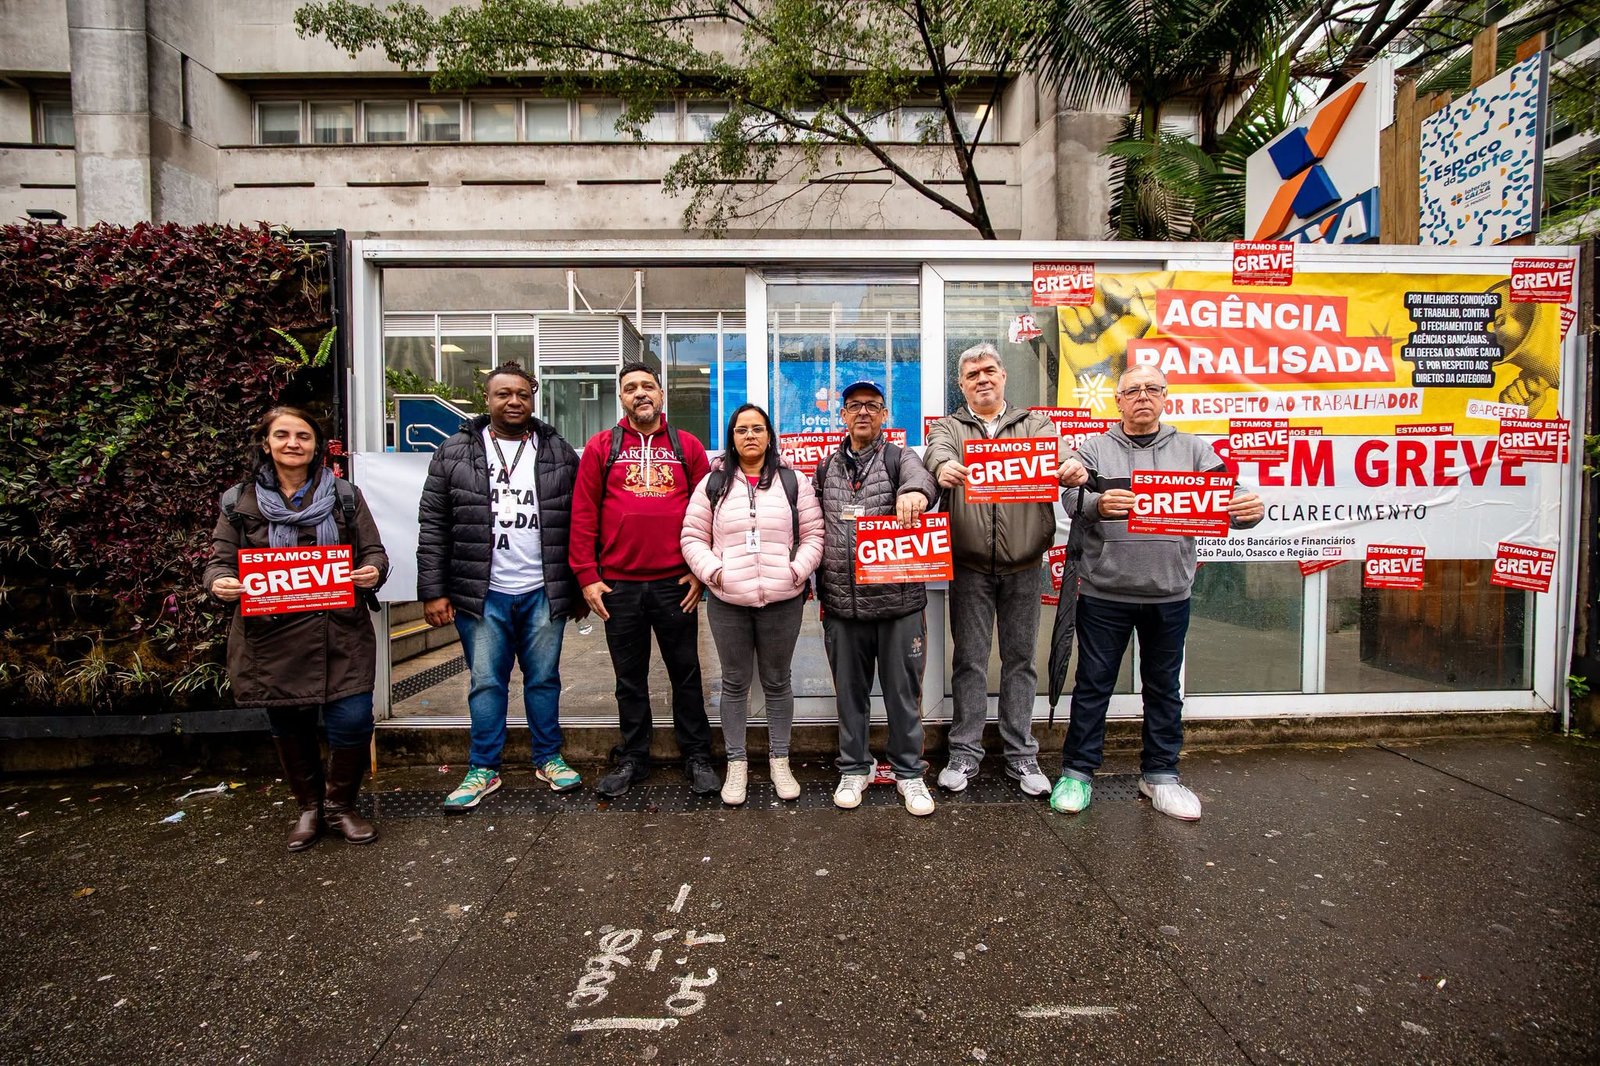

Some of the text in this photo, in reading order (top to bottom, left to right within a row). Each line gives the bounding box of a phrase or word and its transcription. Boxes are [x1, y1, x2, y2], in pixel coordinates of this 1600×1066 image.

[1434, 140, 1502, 181] Espaço
[1443, 149, 1513, 187] da Sorte
[1464, 185, 1491, 201] CAIXA
[1234, 243, 1277, 251] ESTAMOS
[1233, 252, 1293, 272] GREVE
[1513, 261, 1555, 269] ESTAMOS
[1033, 274, 1095, 293] GREVE
[1511, 270, 1572, 290] GREVE
[1408, 293, 1498, 306] POR MELHORES CONDIÇÕES
[1162, 294, 1341, 332] AGÊNCIA
[1413, 308, 1490, 319] DE TRABALHO, CONTRA
[1421, 321, 1484, 331] O FECHAMENTO DE
[1412, 333, 1490, 345] AGÊNCIAS BANCÁRIAS,
[1404, 346, 1501, 357] EM DEFESA DO SAÚDE CAIXA
[1135, 345, 1391, 376] PARALISADA
[1418, 360, 1489, 370] E POR RESPEITO AOS
[1415, 373, 1491, 384] DIRETOS DA CATEGORIA
[1164, 392, 1419, 416] OR RESPEITO AO TRABALHADOR
[1469, 403, 1526, 418] @APCEFSP
[1061, 421, 1105, 429] ESTAMOS
[1396, 425, 1453, 434] ESTAMOS EM
[1501, 420, 1543, 429] ESTAMOS
[781, 436, 824, 444] ESTAMOS
[1229, 430, 1288, 450] GREVE
[1500, 430, 1558, 448] GREVE
[966, 442, 1031, 454] ESTAMOS
[1035, 441, 1056, 451] EM
[966, 453, 1057, 485] GREVE
[1134, 474, 1233, 487] ESTAMOS EM
[1132, 489, 1231, 516] GREVE
[1268, 504, 1428, 522] CLARECIMENTO
[858, 517, 947, 531] ESTAMS EM
[857, 529, 950, 564] GREVE
[1228, 536, 1245, 545] dos
[1247, 536, 1292, 546] Bancários
[1301, 536, 1356, 545] Financiários
[241, 549, 350, 563] ESTAMOS EM
[1197, 548, 1214, 557] São
[1216, 548, 1244, 558] Paulo,
[1246, 549, 1277, 557] Osasco
[1287, 548, 1319, 559] Região
[1322, 547, 1342, 556] CUT
[1367, 546, 1424, 556] ESTAMOS EM
[1498, 545, 1555, 560] ESTAMOS EM
[1366, 557, 1424, 575] GREVE
[1494, 557, 1553, 576] GREVE
[241, 560, 352, 596] GREVE
